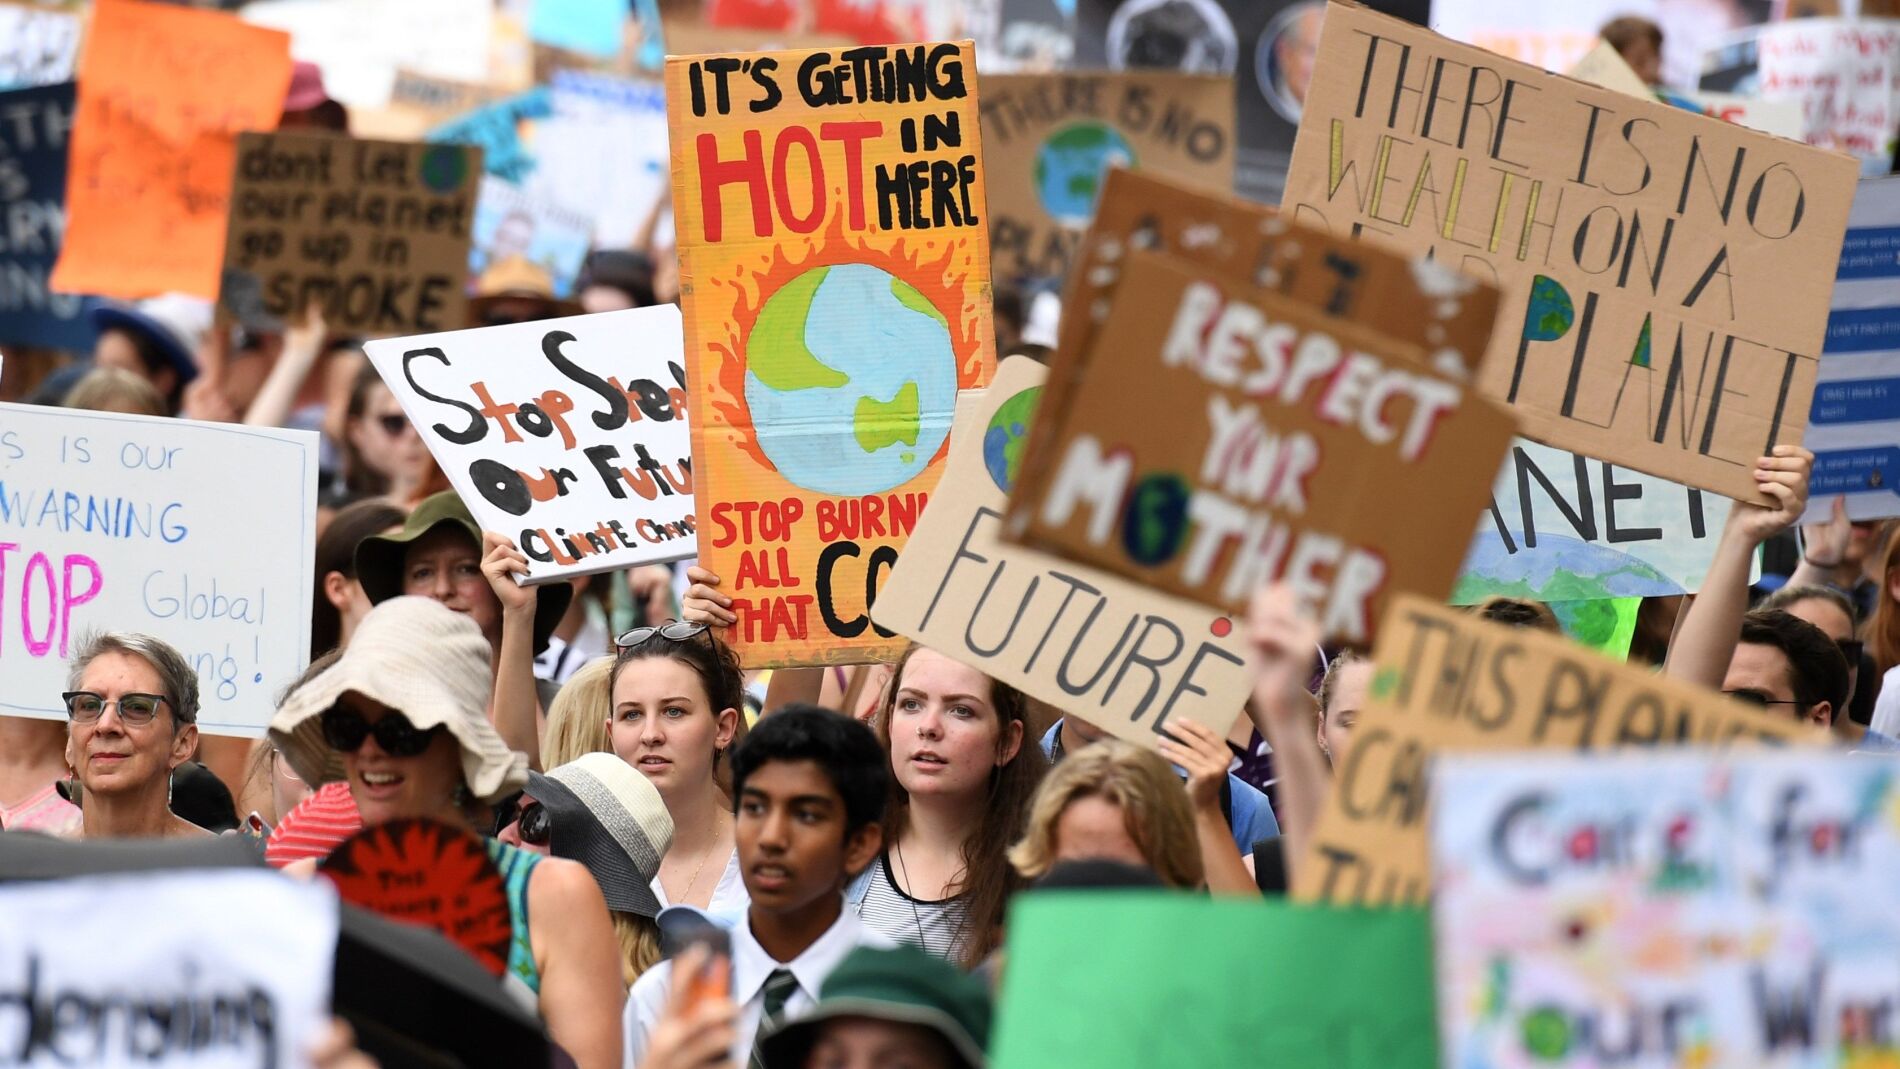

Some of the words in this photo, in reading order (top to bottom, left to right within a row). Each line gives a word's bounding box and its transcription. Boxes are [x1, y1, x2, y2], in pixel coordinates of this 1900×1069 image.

[688, 56, 783, 117] IT'S
[797, 43, 968, 108] GETTING
[354, 144, 407, 189] let
[900, 111, 961, 153] IN
[1157, 102, 1226, 163] NO
[1353, 28, 1543, 169] THERE
[1566, 100, 1662, 197] IS
[1676, 134, 1806, 240] NO
[240, 190, 314, 221] our
[322, 191, 466, 238] planet
[696, 120, 884, 242] HOT
[875, 155, 979, 230] HERE
[241, 227, 284, 268] go
[301, 231, 350, 268] up
[369, 234, 409, 266] in
[1327, 118, 1564, 266] WEALTH
[1572, 205, 1676, 296] ON
[1681, 242, 1735, 320] A
[265, 271, 454, 330] SMOKE
[402, 347, 577, 450] Stop
[1162, 281, 1461, 462] RESPECT
[1506, 274, 1820, 468] PLANET
[0, 480, 188, 544] WARNING
[710, 497, 804, 549] STOP
[1040, 433, 1387, 642] MOTHER
[144, 570, 265, 625] Global
[735, 547, 801, 590] ALL
[728, 595, 815, 644] THAT
[918, 506, 1245, 743] FUTURE
[1397, 610, 1529, 731] THIS
